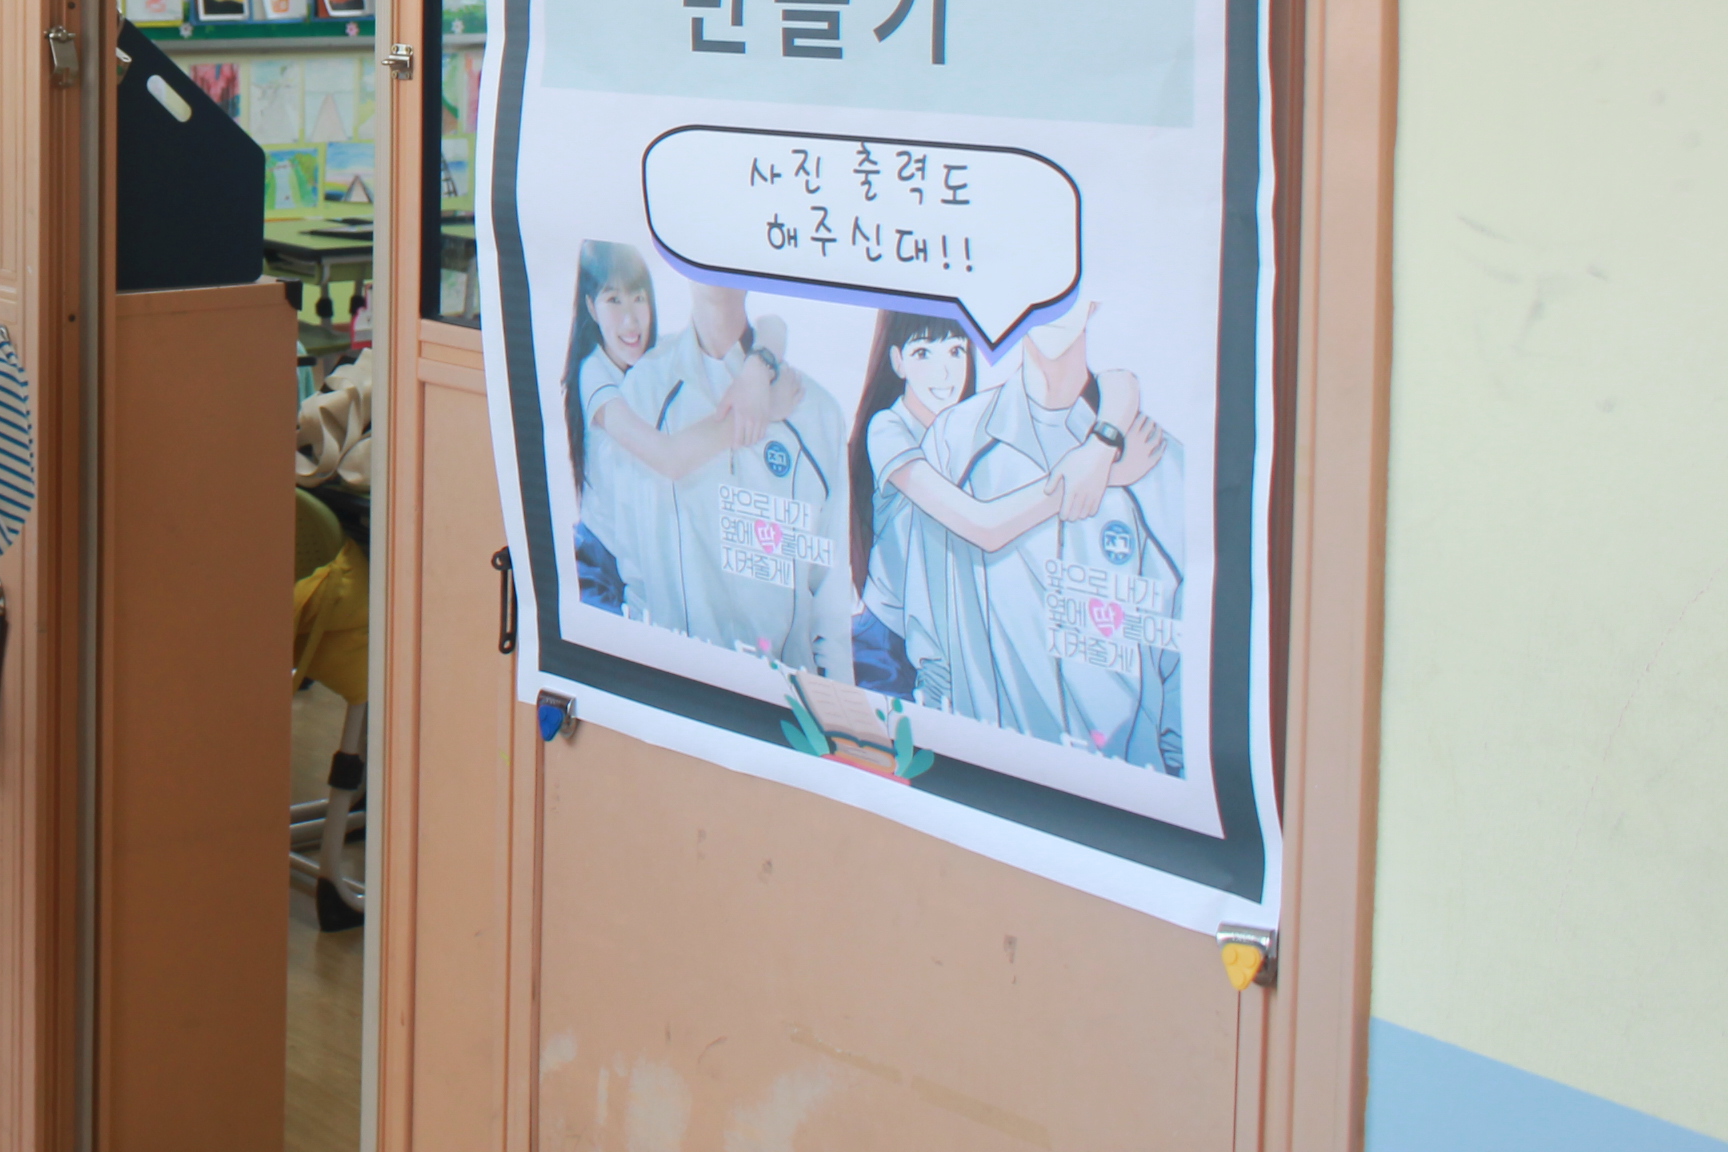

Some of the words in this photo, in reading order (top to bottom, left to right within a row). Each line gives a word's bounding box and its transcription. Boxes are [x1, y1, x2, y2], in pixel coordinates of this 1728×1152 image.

[750, 149, 822, 195] 사진
[852, 142, 971, 206] 출력도
[766, 206, 975, 273] 해주신대!!
[719, 485, 771, 520] 앞으로
[774, 497, 810, 528] 내가
[721, 516, 754, 547] 옆에
[781, 532, 832, 566] 붙어서
[1044, 559, 1109, 598] 앞으로
[1115, 573, 1160, 609] 내가
[1046, 593, 1087, 628] 옆에
